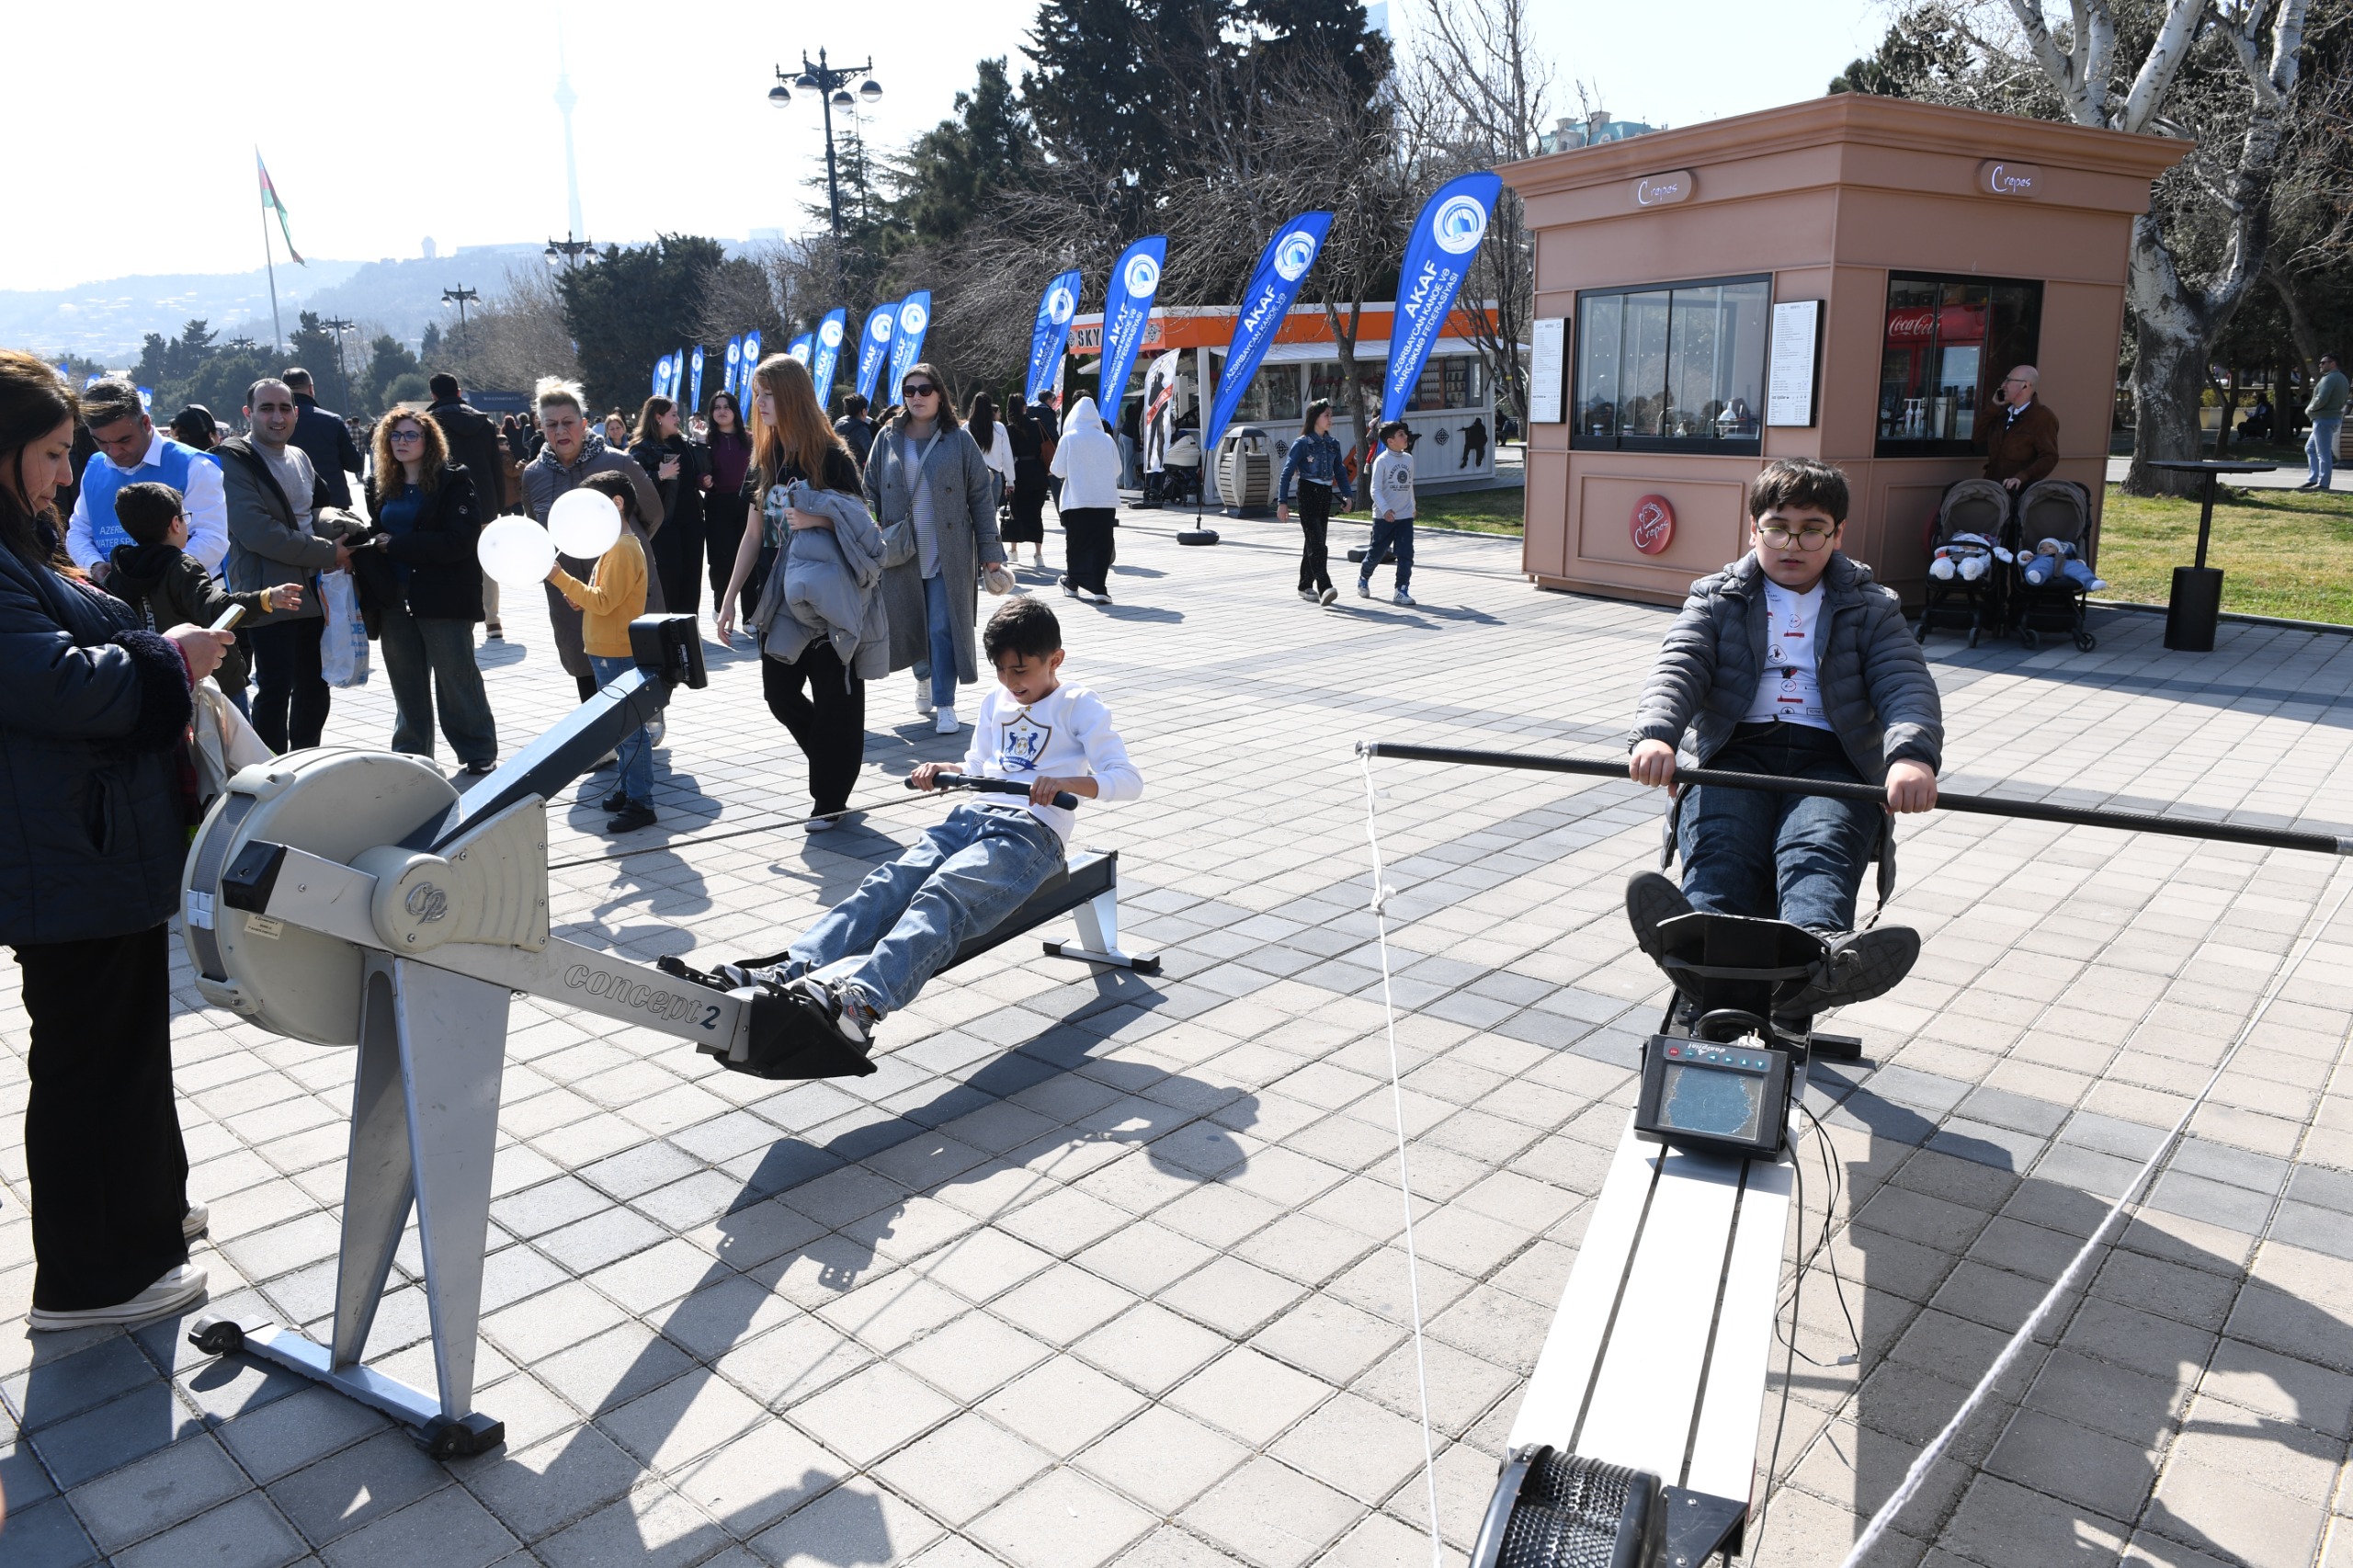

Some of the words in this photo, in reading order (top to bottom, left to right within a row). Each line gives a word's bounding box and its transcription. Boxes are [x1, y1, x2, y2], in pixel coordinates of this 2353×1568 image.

[1638, 178, 1677, 204] Crepes
[1992, 165, 2031, 193] Crepes
[1404, 259, 1438, 319] AKAF
[1108, 302, 1129, 347] AKAF
[1120, 319, 1132, 345] KANOE
[1129, 308, 1137, 319] VƏ
[1244, 284, 1275, 333] AKAF
[1392, 315, 1427, 377] AZƏRBAYCAN
[1422, 282, 1444, 316] KANOE
[1438, 267, 1450, 282] VƏ
[1078, 328, 1100, 347] SKY
[1226, 331, 1261, 380] AZƏRBAYCAN
[1259, 304, 1278, 331] KANOE
[1393, 337, 1426, 393] AVARÇƏKMƏ
[1422, 272, 1459, 337] FEDERASİYASI
[816, 349, 828, 377] AKAF
[861, 344, 876, 374] AKAF
[1105, 360, 1124, 403] AVARÇƏKMƏ
[1120, 312, 1143, 360] FEDERASİYASI
[96, 538, 119, 549] WATER
[1635, 519, 1669, 548] Crepes
